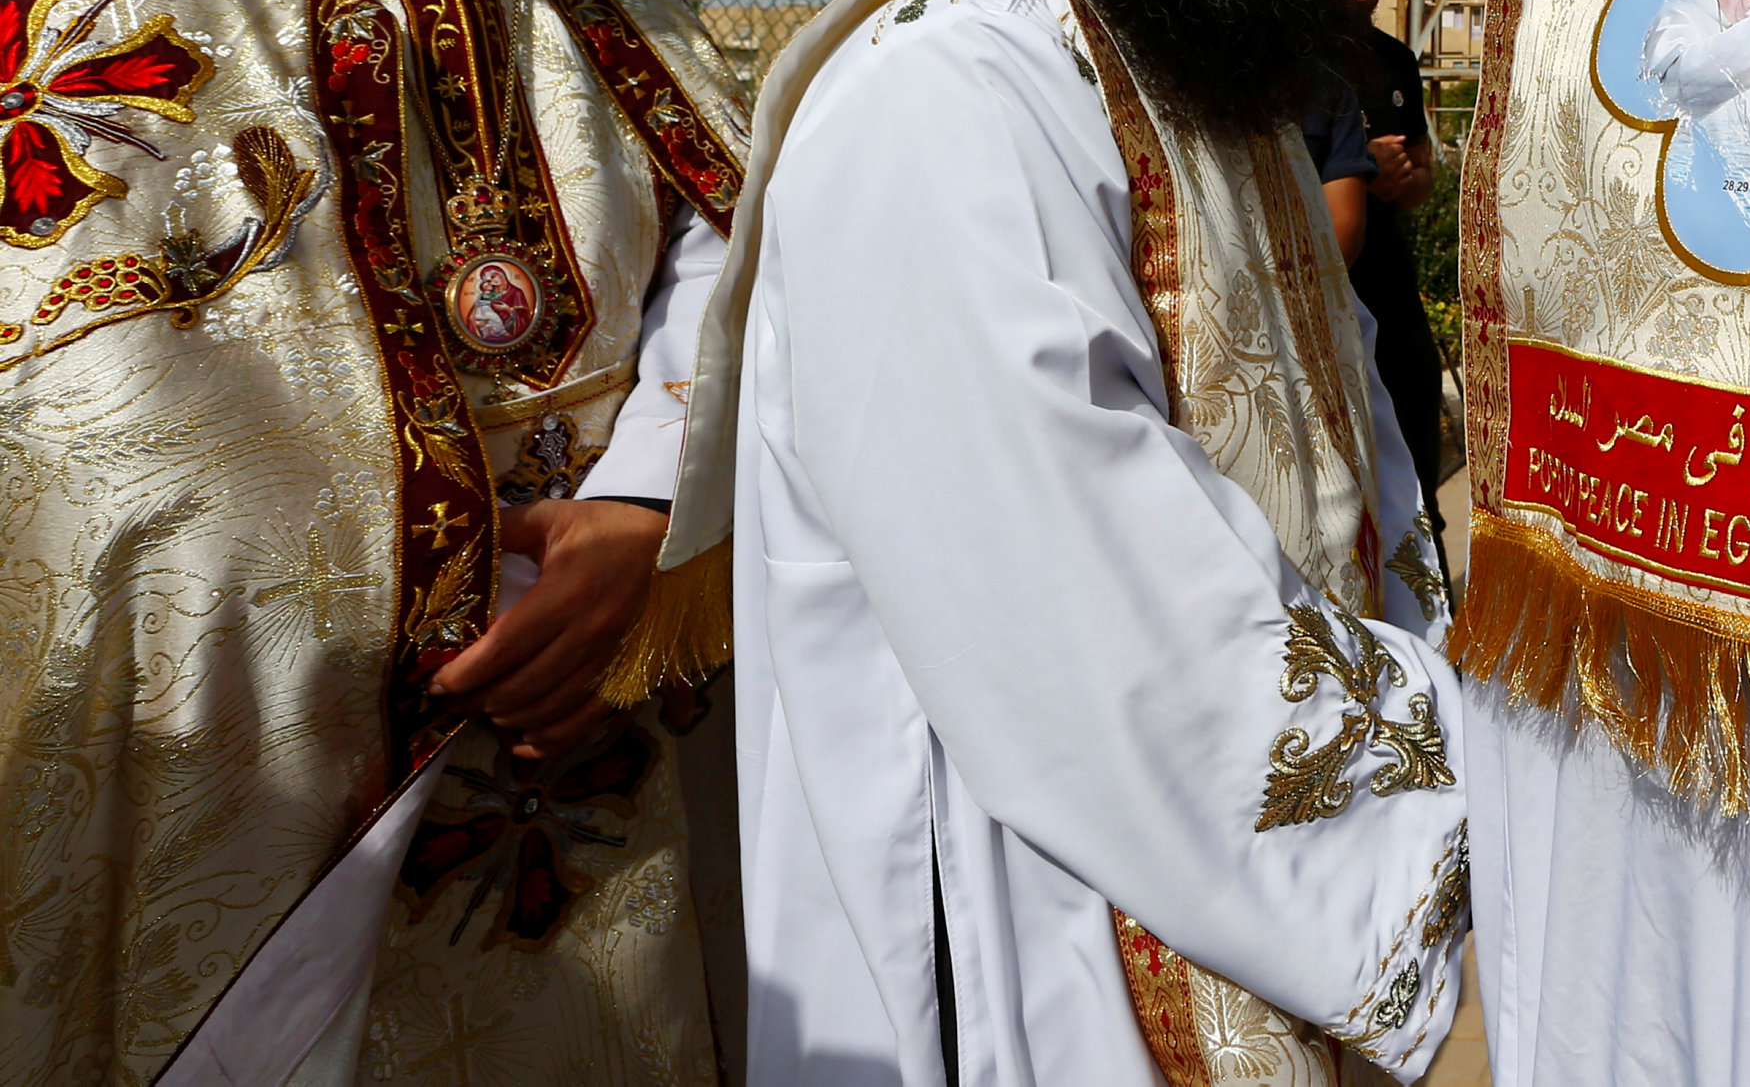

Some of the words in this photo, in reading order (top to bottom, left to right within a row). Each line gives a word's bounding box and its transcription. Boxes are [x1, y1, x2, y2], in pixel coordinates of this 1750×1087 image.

[1722, 180, 1749, 192] 28,29
[1596, 412, 1674, 452] مصر
[1577, 472, 1649, 538] PEACE
[1654, 498, 1689, 553] IN
